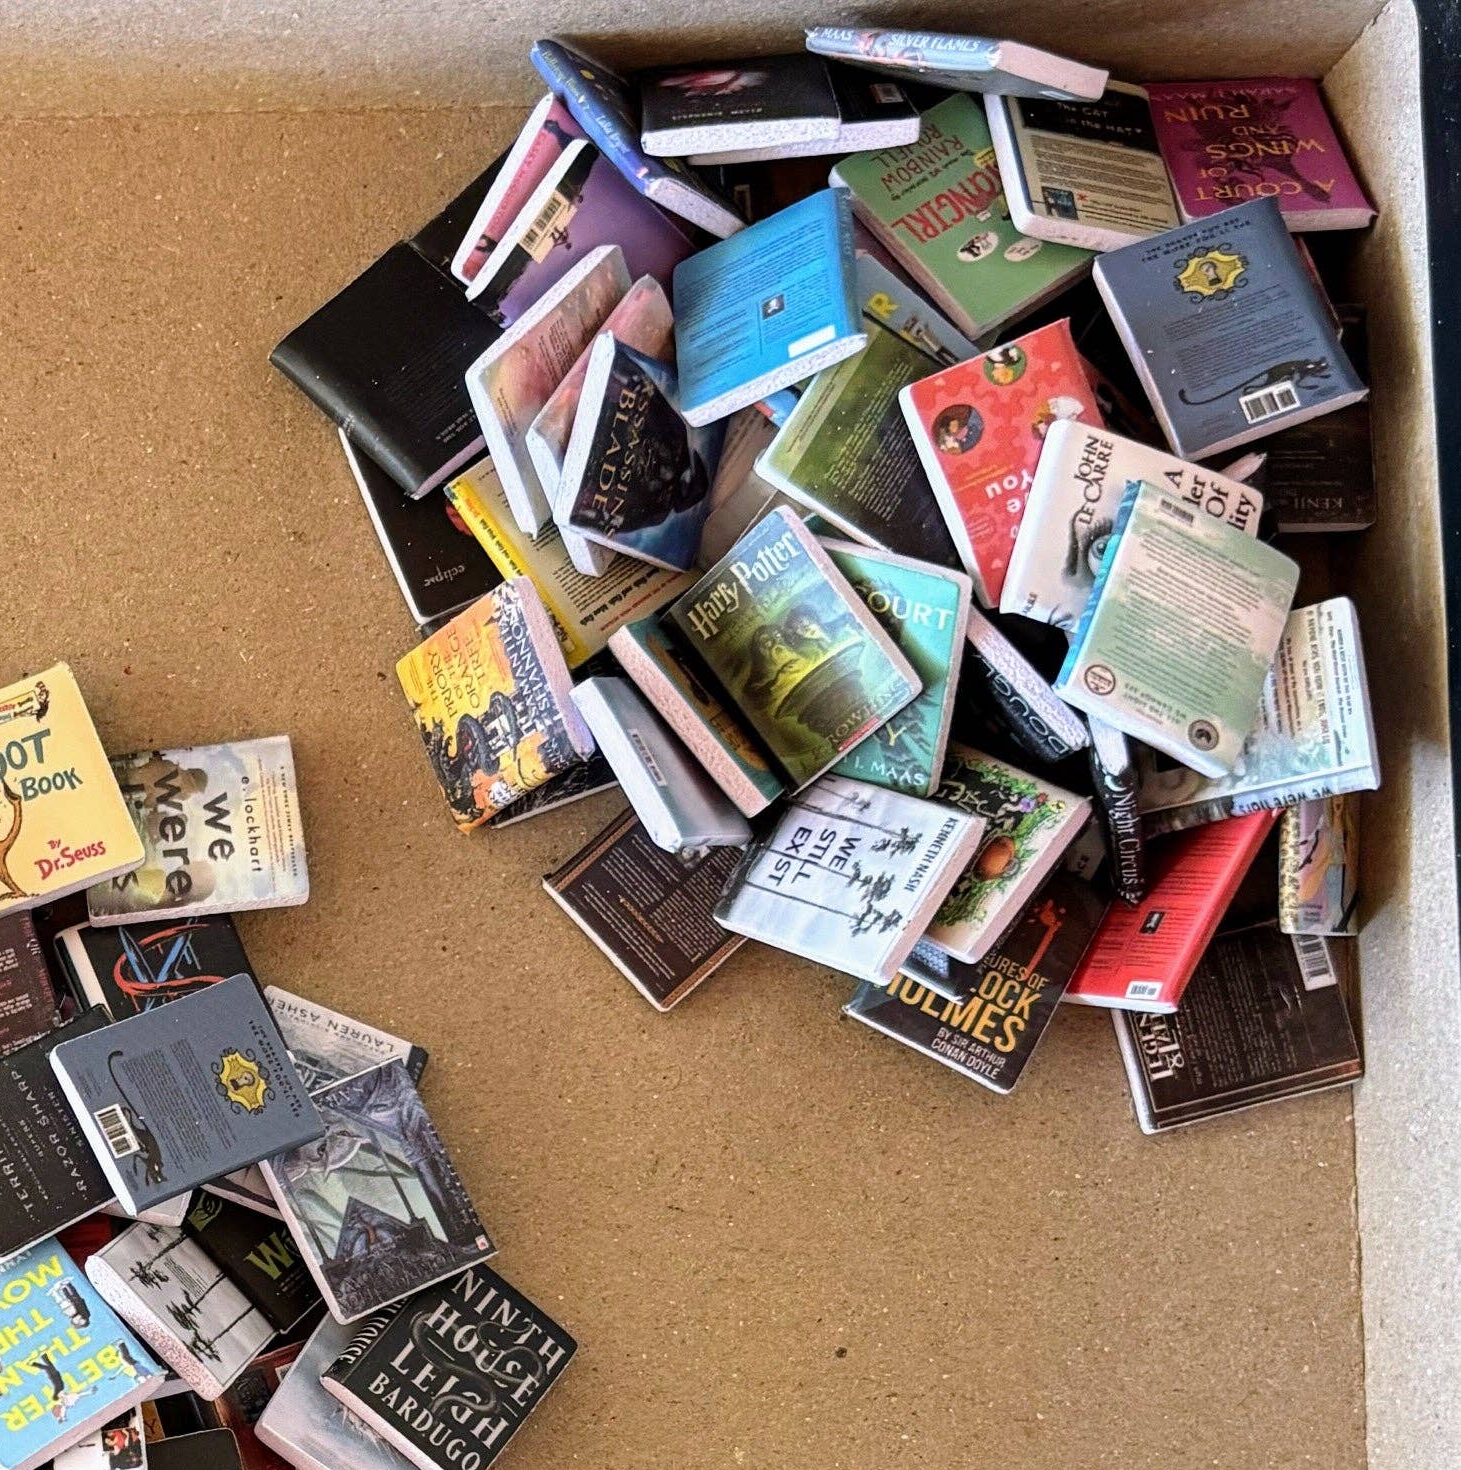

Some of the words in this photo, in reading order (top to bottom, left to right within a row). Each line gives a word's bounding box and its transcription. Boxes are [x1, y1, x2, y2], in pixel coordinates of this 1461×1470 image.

[1165, 103, 1250, 122] RUIN
[1204, 138, 1325, 159] WINGS
[1194, 181, 1303, 201] COURT
[591, 389, 636, 511] BLADE
[1072, 435, 1101, 485] JOHN
[986, 468, 1031, 499] You
[1162, 468, 1184, 488] A
[1078, 497, 1095, 525] LE
[1205, 481, 1231, 520] Of
[686, 575, 739, 641] Harry
[733, 530, 803, 604] Potter
[427, 651, 458, 718] PRIORY
[19, 767, 84, 803] BOOK
[870, 756, 926, 788] MAAS
[201, 791, 236, 864] we
[1109, 785, 1139, 836] Night
[48, 839, 63, 851] BY
[153, 769, 194, 898] were
[830, 835, 862, 872] WE
[921, 816, 960, 866] KENNETH
[903, 864, 929, 893] NASH
[1027, 975, 1050, 991] OF
[931, 1038, 966, 1065] CONAN
[963, 1054, 1000, 1080] DOYLE
[937, 1027, 952, 1041] BY
[950, 1034, 970, 1049] SIR
[967, 1040, 1007, 1069] ARTHUR
[451, 1268, 566, 1375] NINTH
[425, 1300, 539, 1409] HOUSE
[389, 1341, 510, 1450] LEIGH
